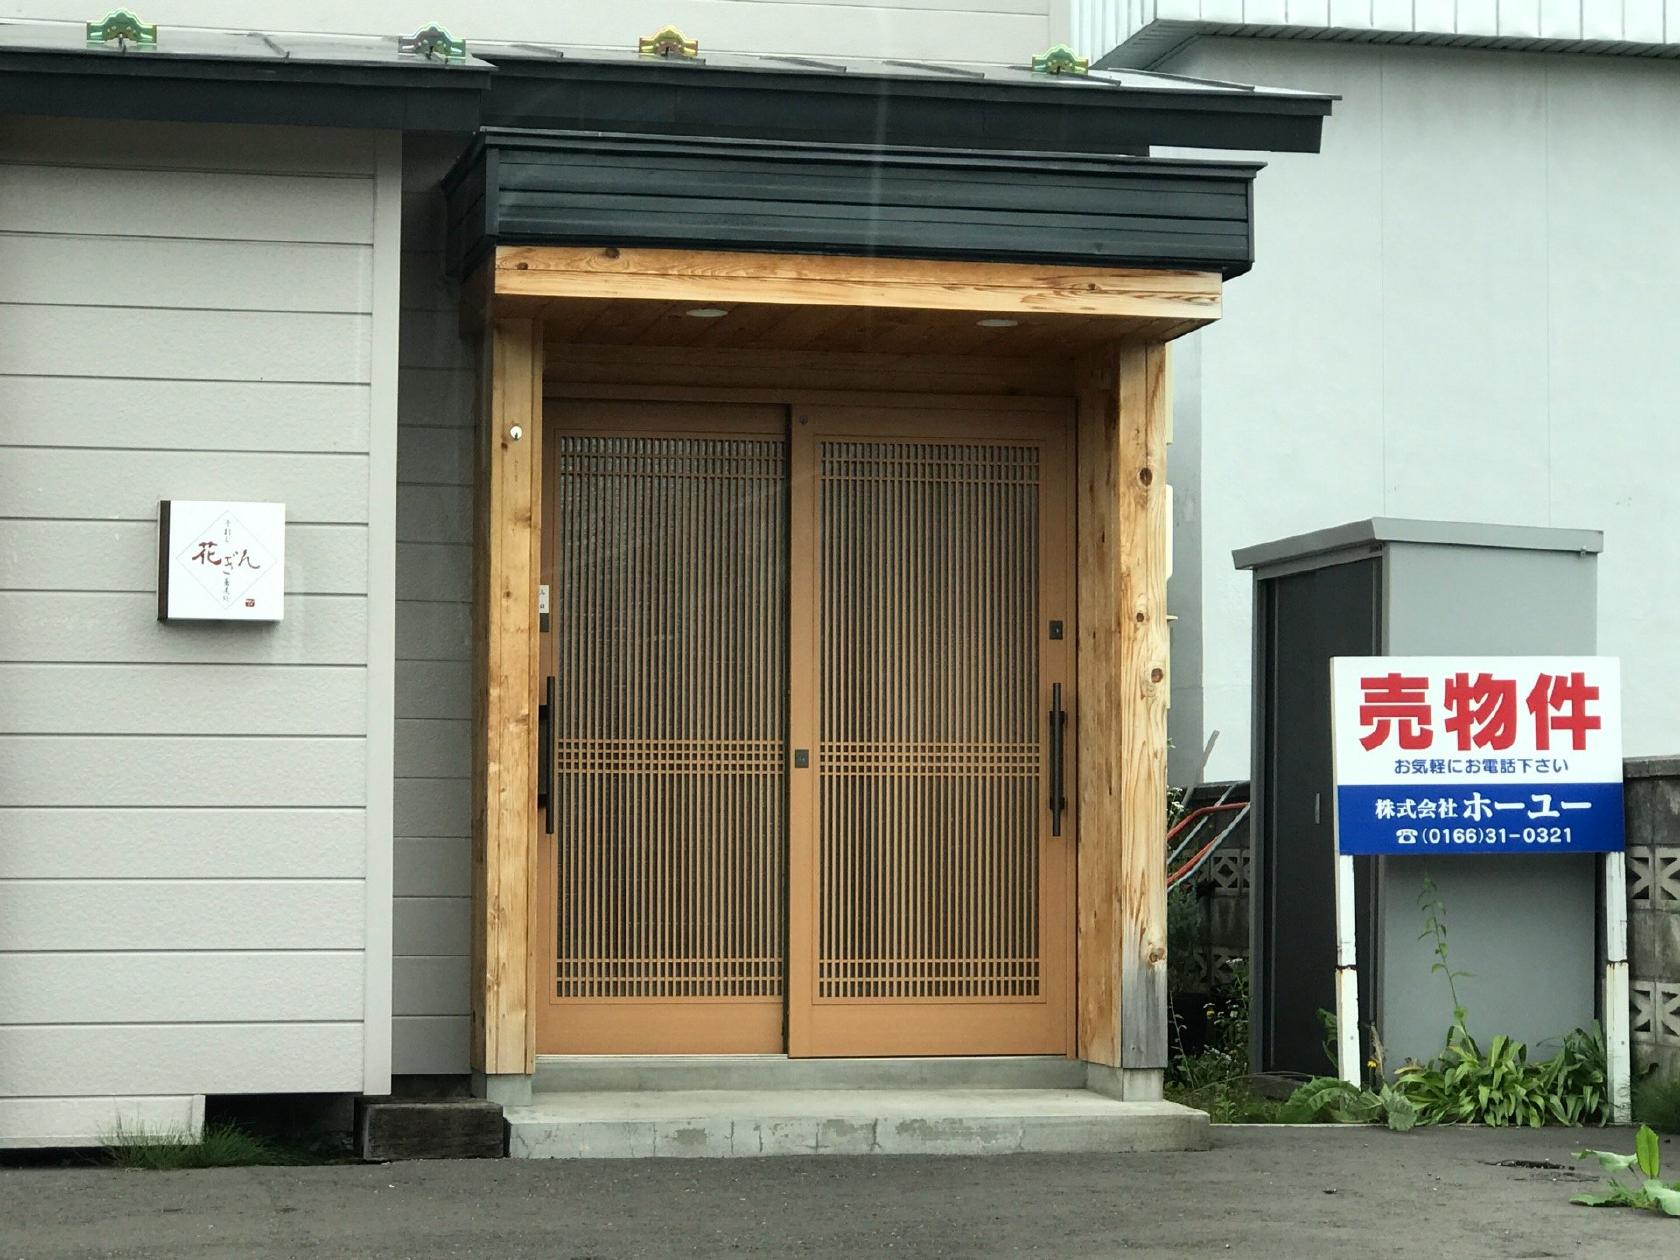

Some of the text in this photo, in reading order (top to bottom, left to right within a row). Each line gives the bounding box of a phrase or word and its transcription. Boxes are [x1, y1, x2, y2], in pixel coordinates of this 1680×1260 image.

[1359, 672, 1601, 752] 売物件
[1394, 758, 1569, 775] お気軽にお電話下さい
[1422, 828, 1572, 844] (0166)31-0321
